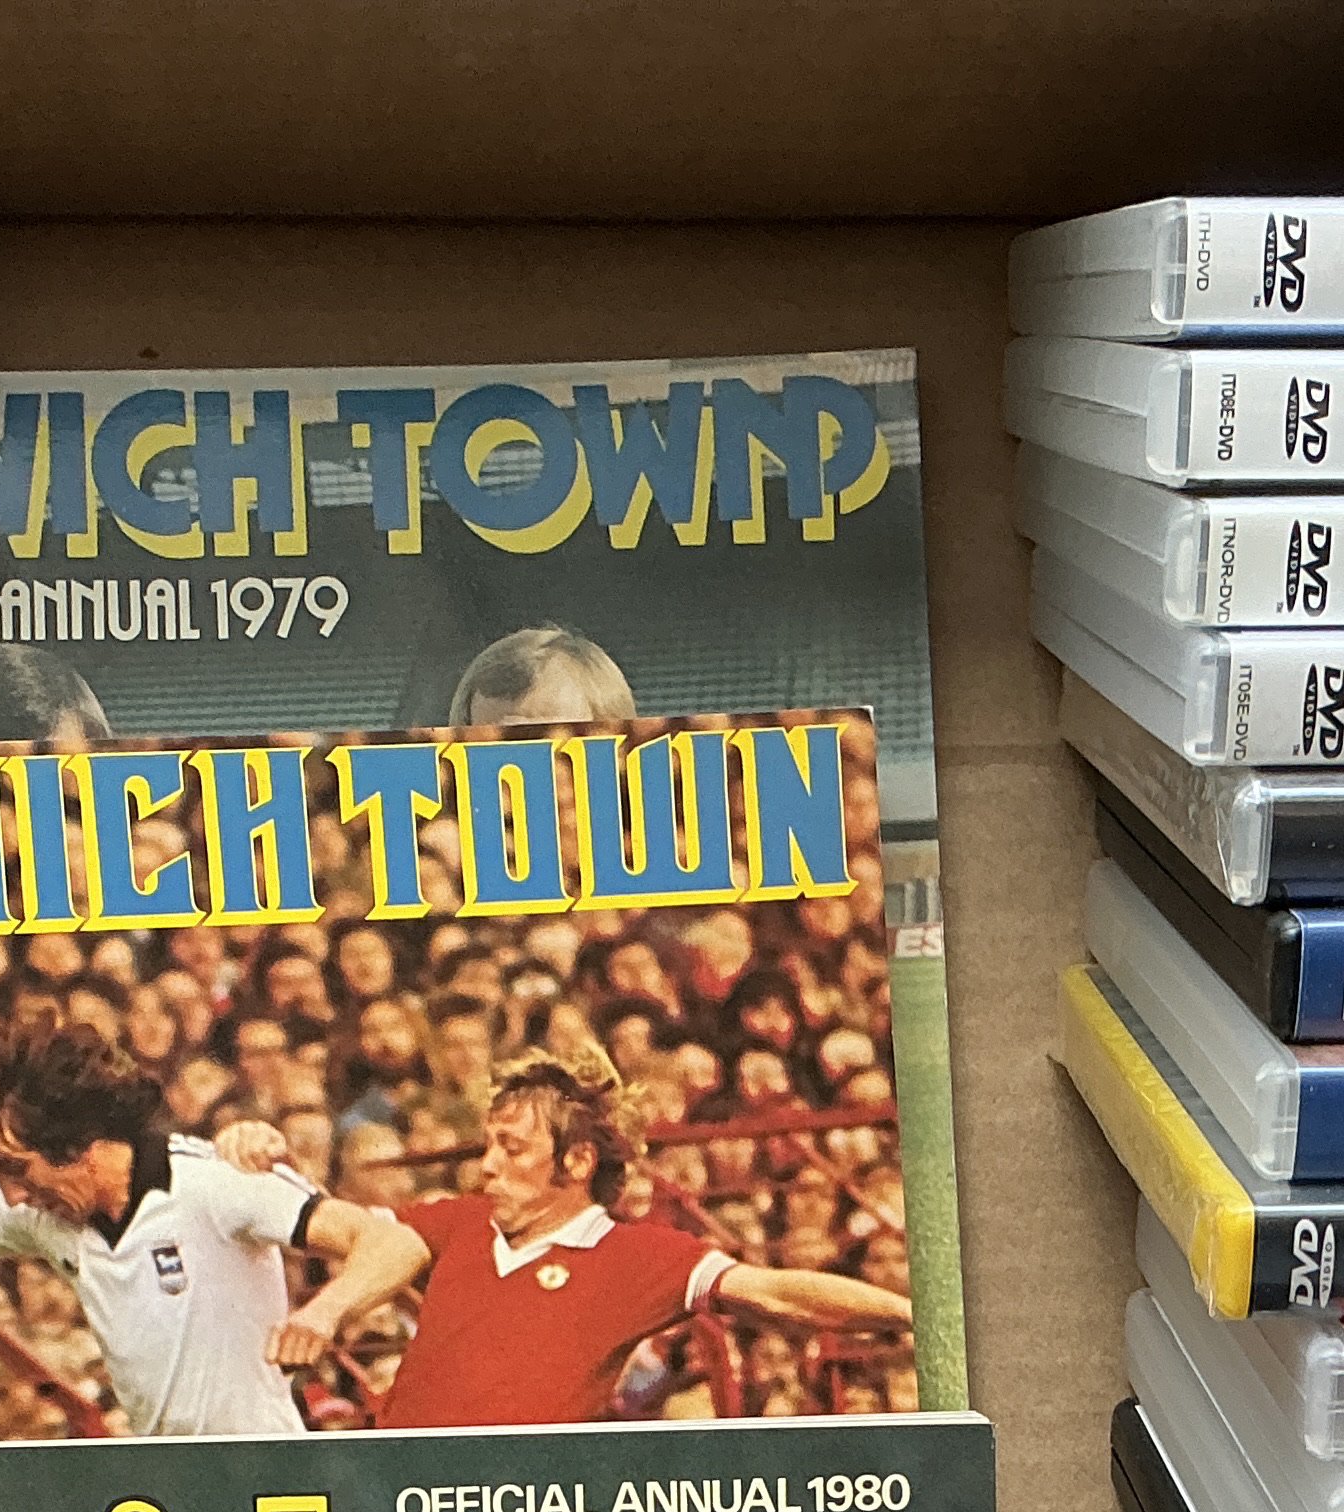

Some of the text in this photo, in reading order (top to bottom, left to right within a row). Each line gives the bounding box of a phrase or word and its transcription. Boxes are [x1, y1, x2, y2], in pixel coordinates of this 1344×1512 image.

[210, 575, 350, 641] 1979
[1303, 522, 1332, 617] DVD
[335, 722, 861, 920] TOWN
